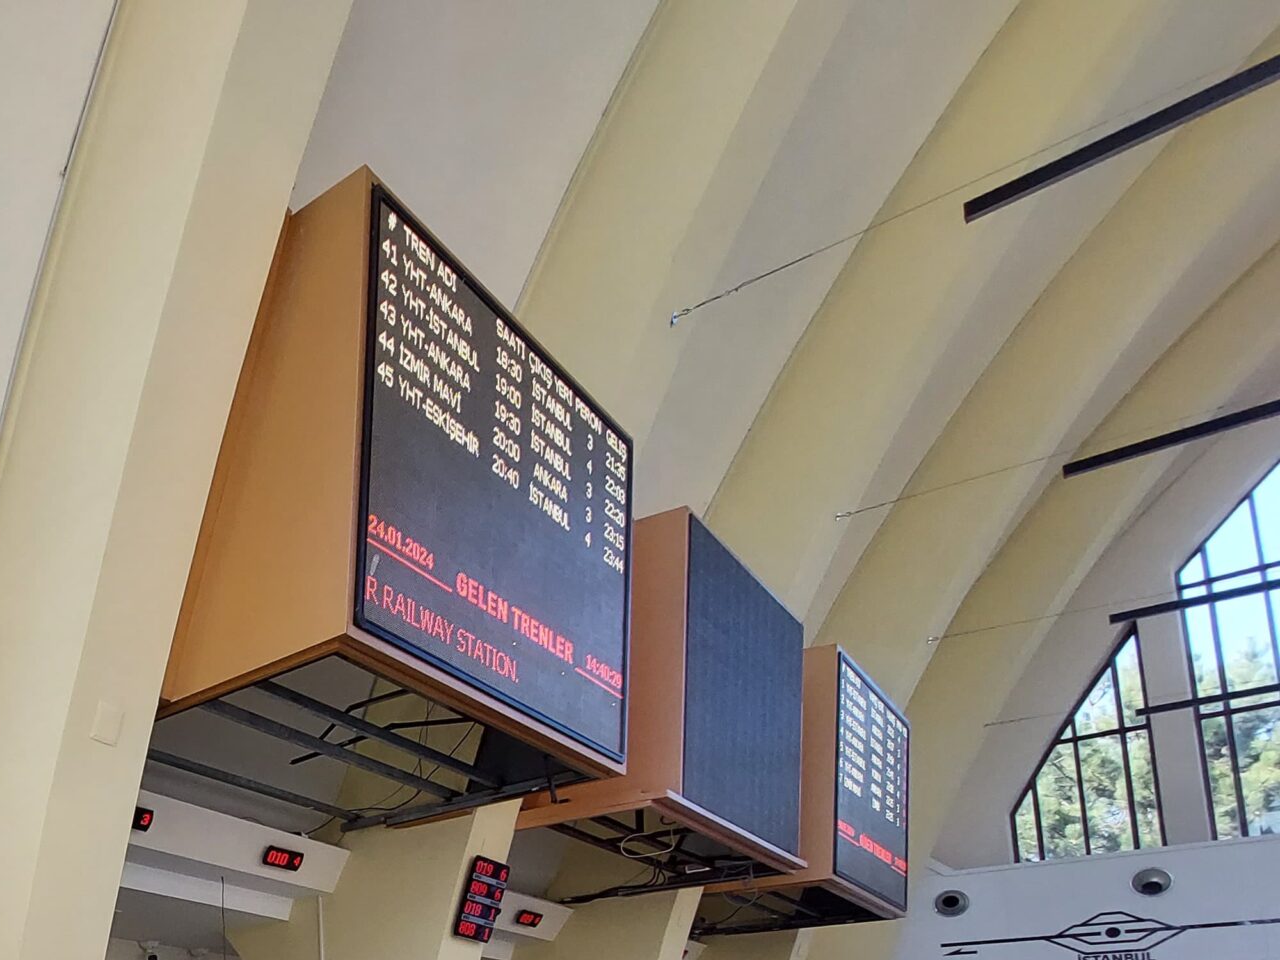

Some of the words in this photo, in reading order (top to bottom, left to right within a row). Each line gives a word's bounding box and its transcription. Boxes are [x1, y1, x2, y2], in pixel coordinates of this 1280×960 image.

[381, 269, 398, 297] 42
[402, 283, 480, 372] YHT-İSTANBUL
[495, 373, 521, 410] 19:00
[531, 403, 572, 457] İSTANBUL
[587, 459, 592, 475] 4
[382, 238, 398, 267] 41
[403, 254, 472, 337] YHT-ANKARA
[496, 346, 523, 383] 18:30
[532, 377, 573, 432] İSTANBUL
[587, 433, 593, 451] 3
[605, 452, 626, 482] 21:35
[404, 224, 435, 271] TREN
[437, 261, 457, 293] ADI
[575, 397, 602, 435] PERON
[377, 361, 394, 388] 45
[492, 454, 519, 489] 20:40
[529, 481, 570, 532] İSTANBUL
[585, 532, 591, 548] 4
[603, 546, 624, 574] 23:44
[378, 330, 395, 357] 44
[399, 341, 431, 388] İZMİR
[433, 374, 462, 414] MAVİ
[493, 426, 520, 462] 20:00
[533, 462, 568, 503] ANKARA
[585, 506, 592, 523] 3
[604, 522, 625, 552] 23:15
[380, 300, 396, 327] 43
[401, 313, 471, 393] YHT-ANKARA
[494, 400, 521, 436] 19:30
[531, 429, 572, 481] İSTANBUL
[586, 482, 592, 499] 3
[604, 499, 625, 528] 22:20
[368, 514, 435, 570] 24.01.2024
[456, 572, 508, 623] GELEN
[511, 606, 574, 665] TRENLER
[382, 585, 455, 645] RAILWAY
[456, 628, 519, 684] STATION.
[140, 814, 151, 826] 3
[267, 850, 289, 866] 010
[293, 856, 301, 866] 4
[476, 861, 493, 876] 019
[500, 869, 507, 881] 6
[464, 901, 482, 916] 018
[489, 908, 495, 920] 1
[483, 928, 490, 940] 1
[494, 889, 502, 900] 6
